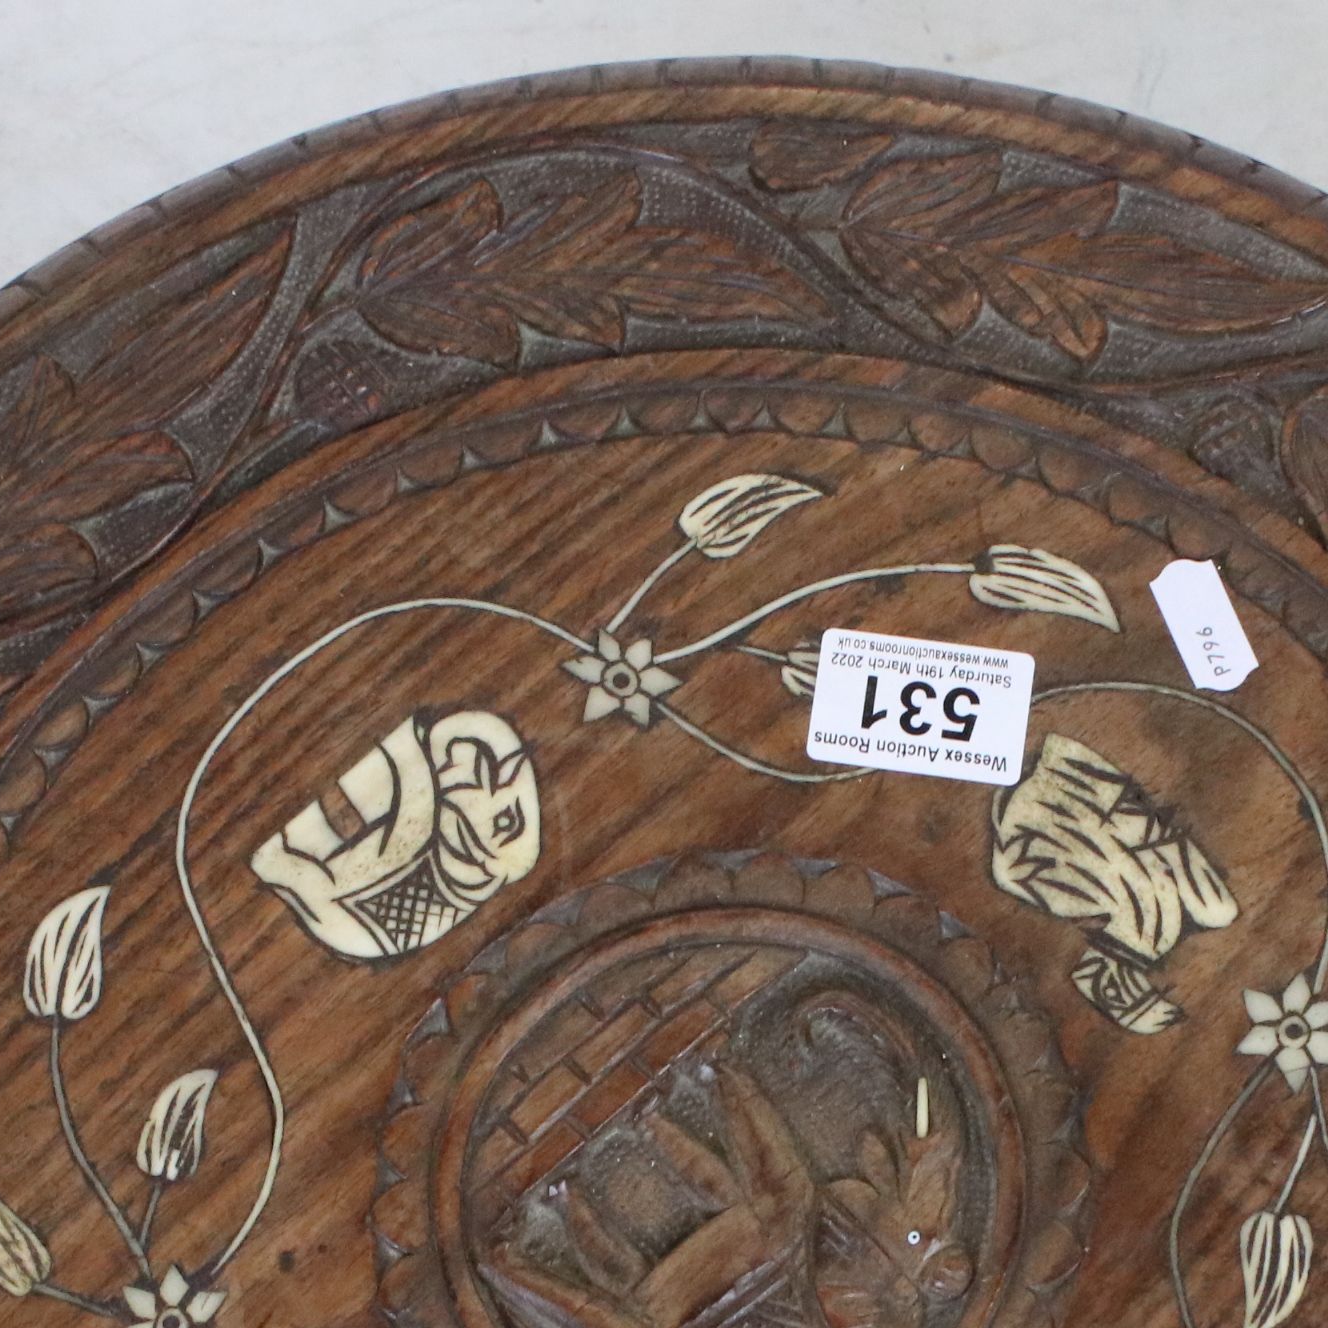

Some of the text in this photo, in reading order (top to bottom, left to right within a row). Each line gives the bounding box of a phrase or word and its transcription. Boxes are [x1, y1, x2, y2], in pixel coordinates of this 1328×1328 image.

[831, 651, 1012, 688] Saturday 19th March 2022
[837, 636, 1009, 668] www.wessexauctionrooms.co.uk
[1195, 626, 1232, 677] P796
[861, 675, 981, 742] 531
[814, 731, 1007, 773] Wessex Auction Rooms
